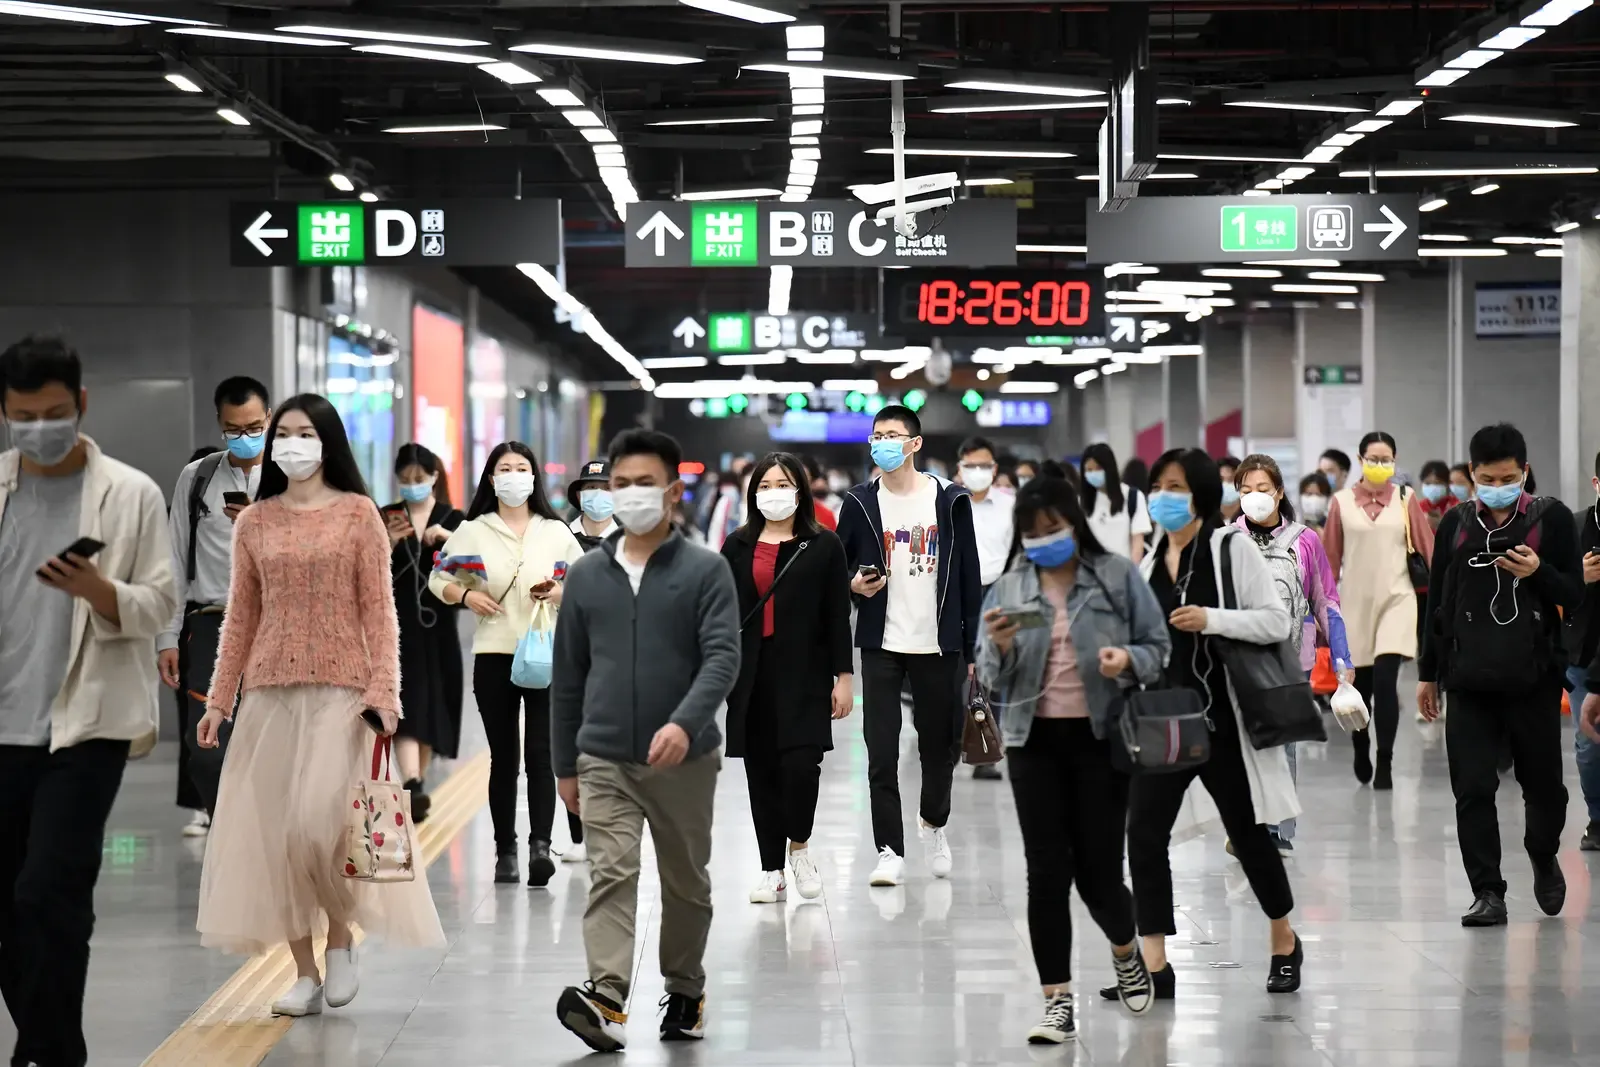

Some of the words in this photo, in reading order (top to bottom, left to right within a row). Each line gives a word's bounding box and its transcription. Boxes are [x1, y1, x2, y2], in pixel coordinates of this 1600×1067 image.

[312, 243, 350, 257] EXIT
[375, 209, 417, 257] D
[769, 211, 808, 257] B
[848, 210, 887, 257] C
[918, 280, 1090, 326] 18:26:00
[1515, 294, 1558, 313] 1112
[754, 316, 782, 348] B
[802, 315, 830, 348] C
